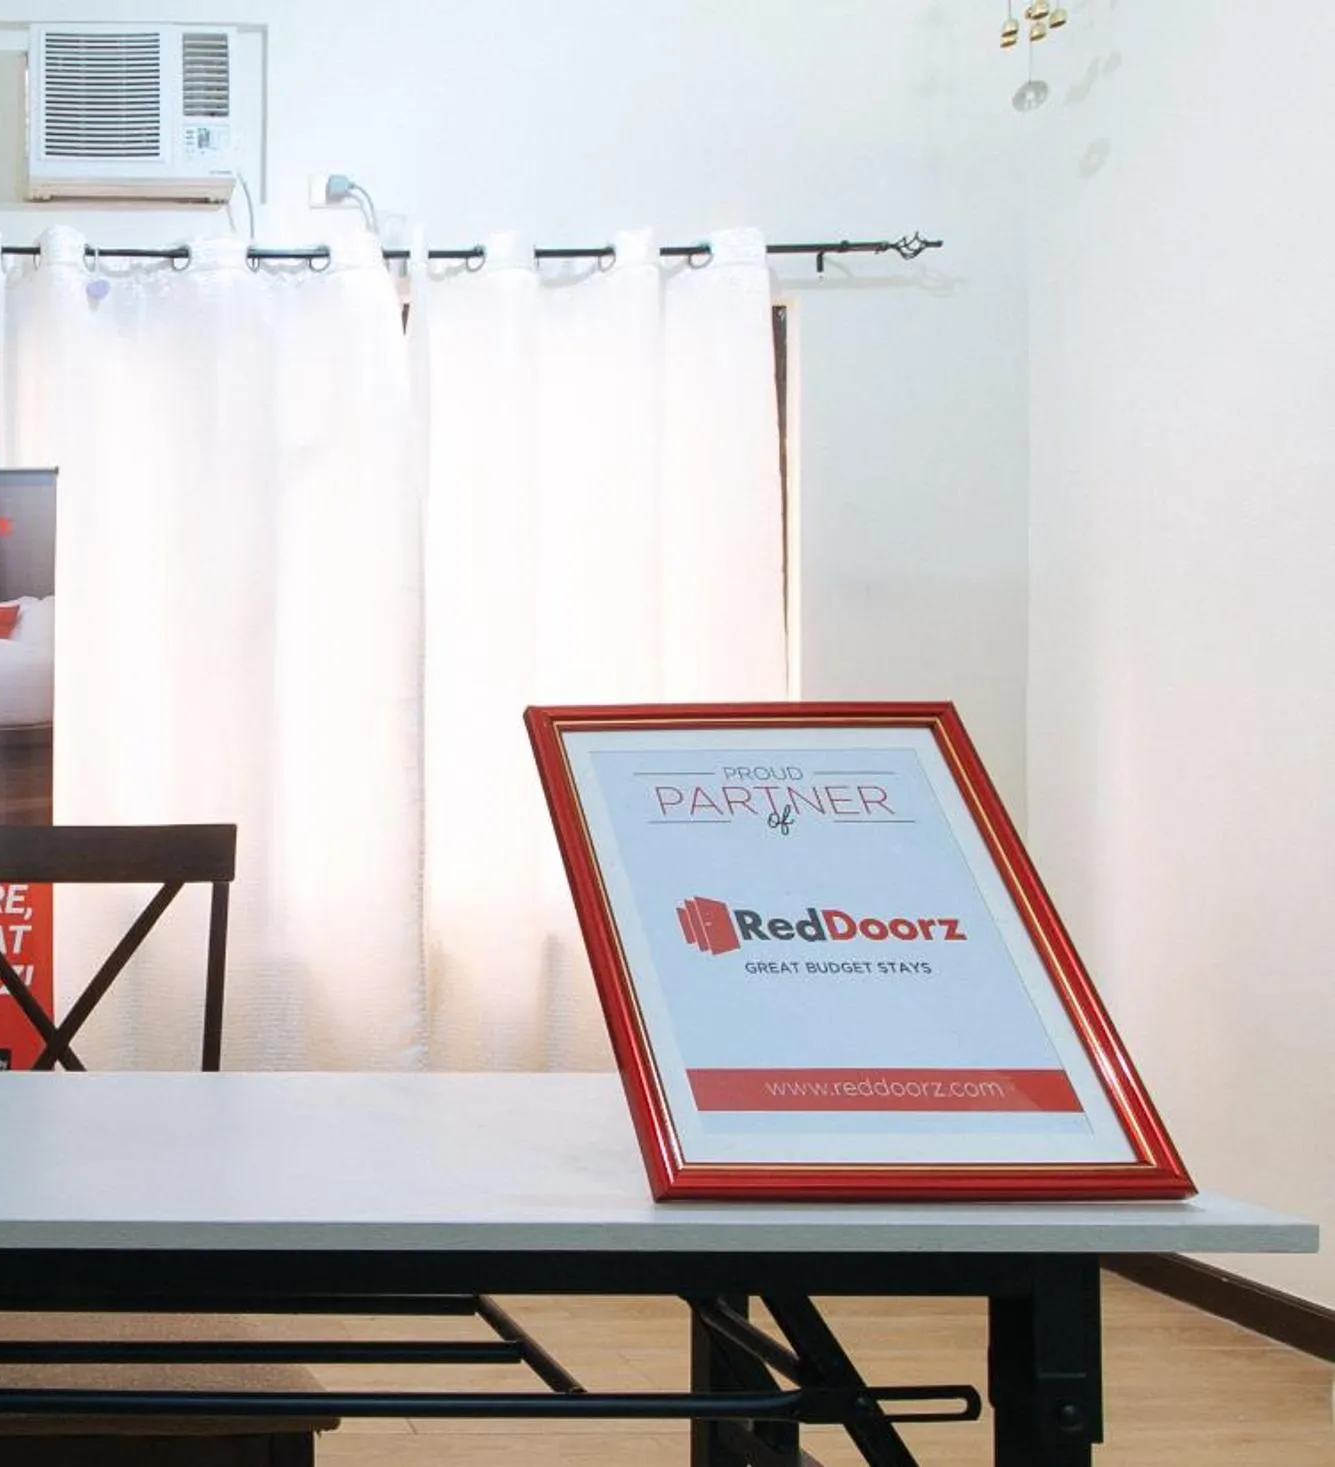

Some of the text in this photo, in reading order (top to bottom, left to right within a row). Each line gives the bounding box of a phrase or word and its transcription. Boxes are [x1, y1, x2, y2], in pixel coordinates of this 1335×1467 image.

[723, 766, 804, 781] PROUD
[655, 786, 896, 816] PARTNER
[767, 804, 794, 835] of
[733, 907, 968, 942] RedDoorz
[745, 961, 932, 974] GREAT BUDGET STAYS
[765, 1078, 1005, 1098] www.reddoorz.com
